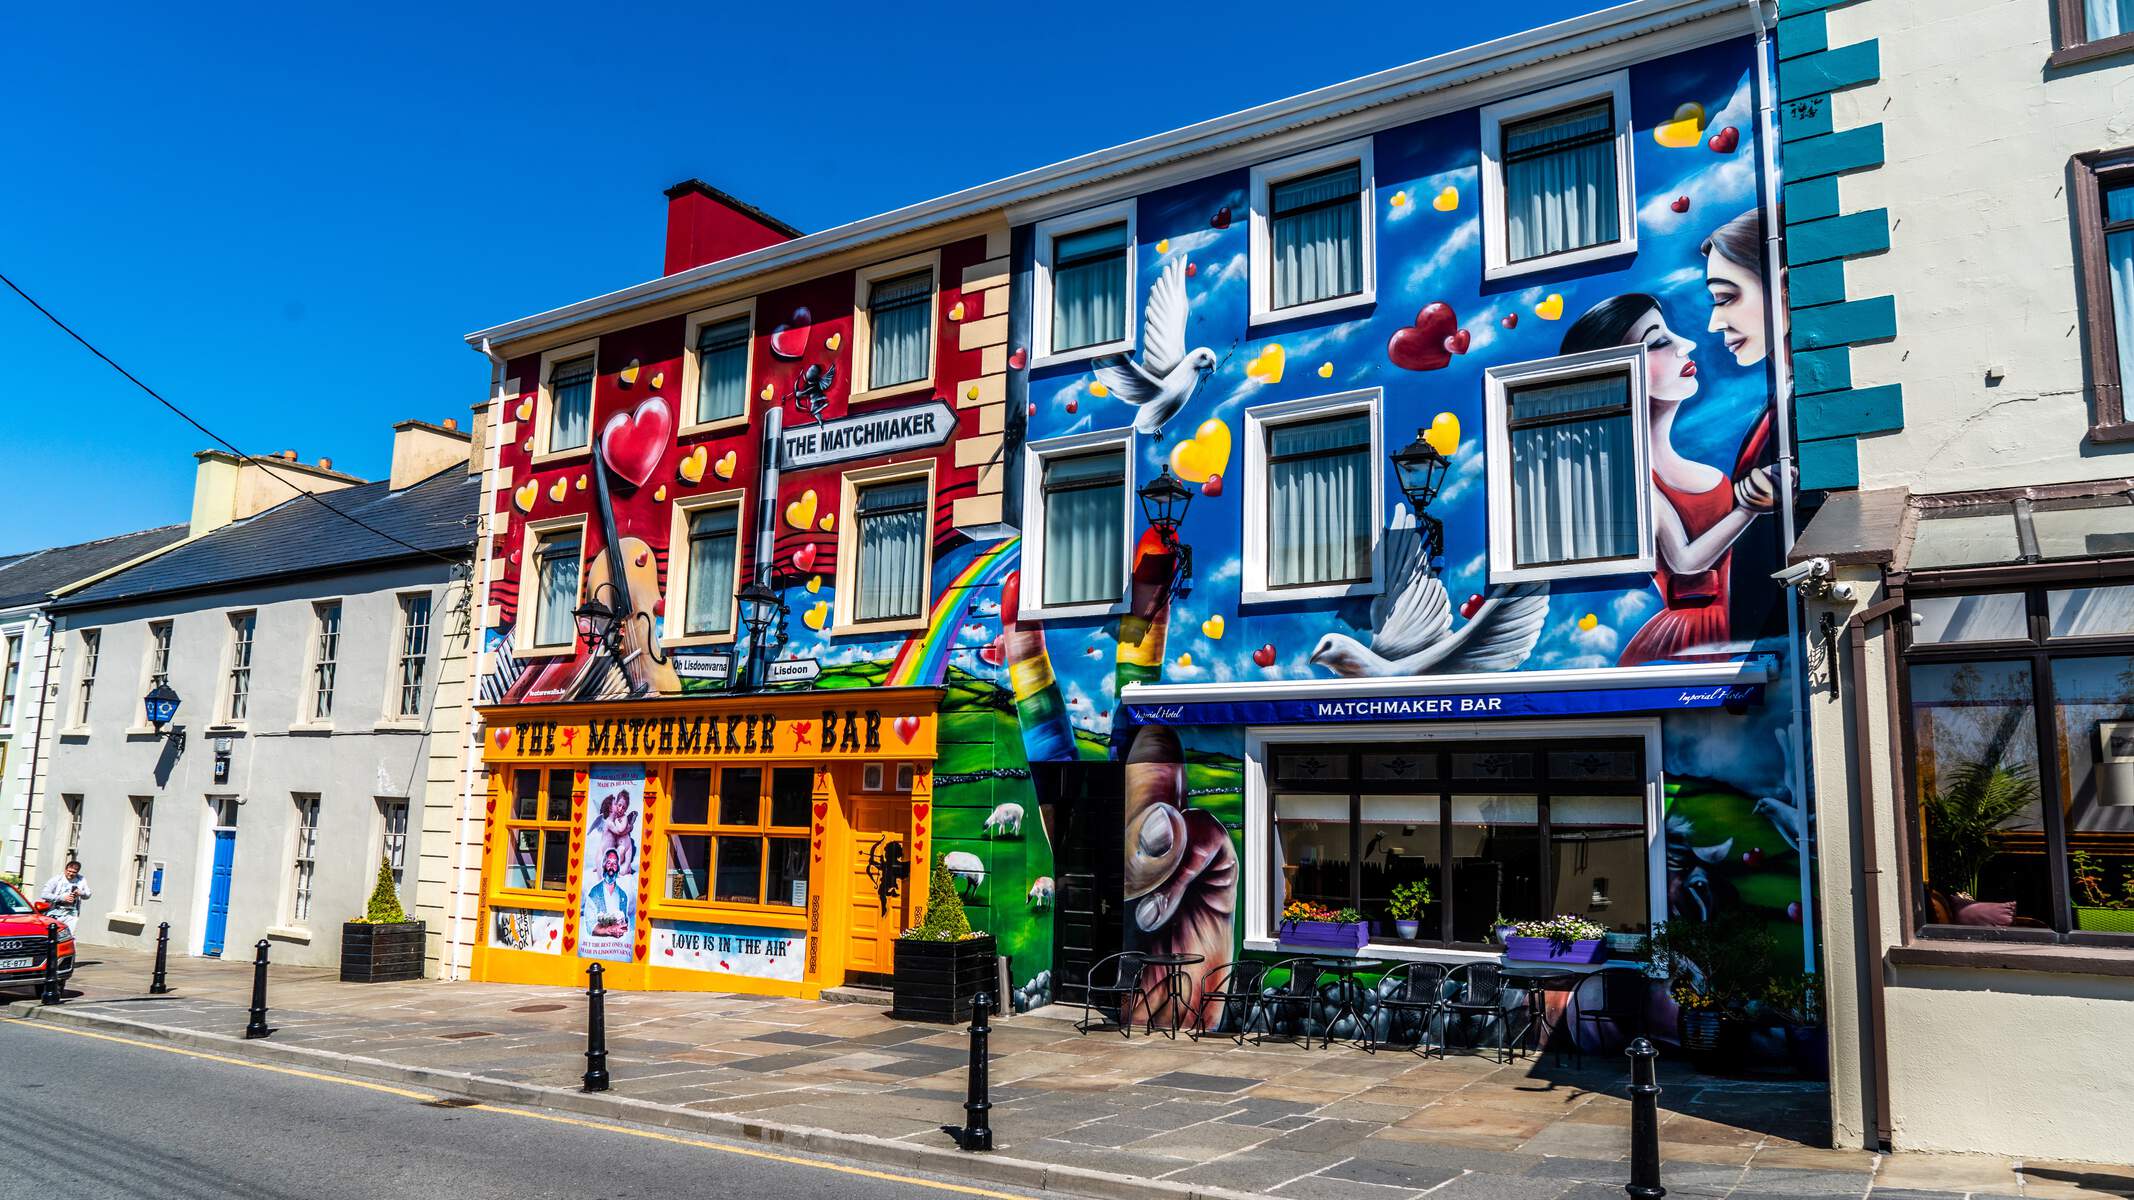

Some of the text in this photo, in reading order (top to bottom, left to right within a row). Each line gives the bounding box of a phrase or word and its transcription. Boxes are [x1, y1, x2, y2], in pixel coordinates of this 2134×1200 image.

[786, 412, 935, 458] THE MATCHMAKER
[684, 660, 728, 672] Lisdoonvarna
[773, 664, 808, 676] Lisdoon
[1678, 686, 1755, 705] Imperial Hotel
[1161, 705, 1184, 719] Hotel
[1318, 697, 1502, 716] MATCHMAKER BAR
[516, 710, 881, 755] THE MATCHMAKER BAR
[672, 933, 787, 957] LOVE IS IN THE AIR
